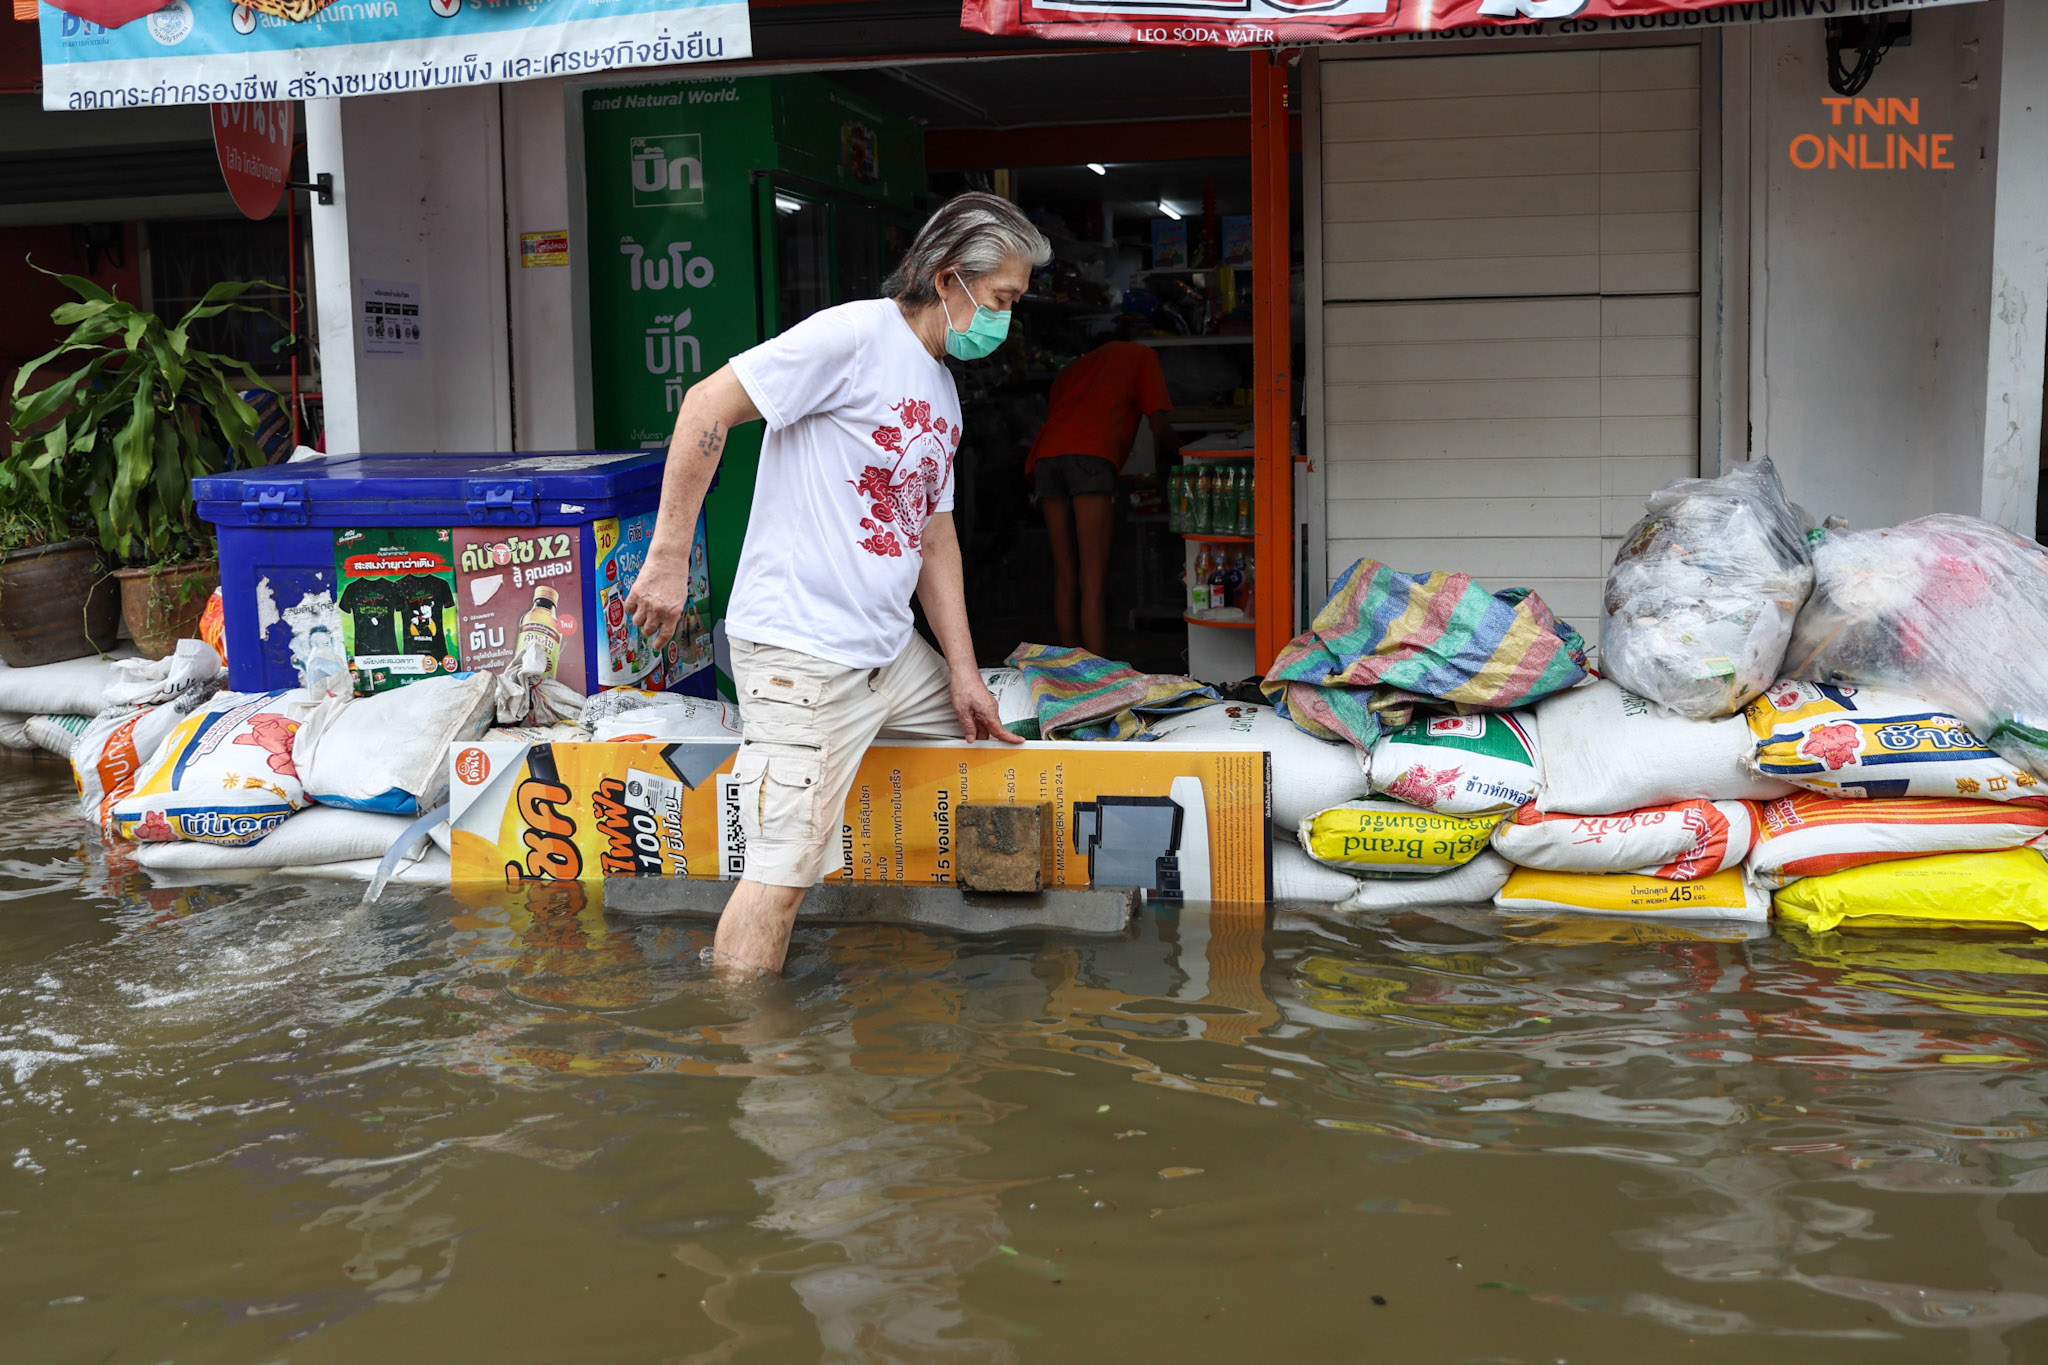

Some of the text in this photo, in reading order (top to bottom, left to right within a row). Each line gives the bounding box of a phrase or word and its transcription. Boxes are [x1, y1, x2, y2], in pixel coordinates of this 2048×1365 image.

[1137, 27, 1167, 42] LEO
[1174, 26, 1220, 42] SODA
[1225, 28, 1275, 43] WATER
[68, 74, 278, 110] ลดภาระค่าครองชีพ
[502, 28, 724, 79] และเศรษฐกิจยั่งยืน
[592, 88, 740, 111] and Natural World.
[620, 241, 715, 291] ไบโอ
[537, 534, 571, 561] X2
[354, 558, 435, 571] สะสมง่ายกว่าเดิม
[560, 620, 573, 629] ใหม่
[469, 622, 505, 651] ตับ
[958, 762, 968, 774] 65
[1003, 768, 1016, 780] นิ้ว
[1055, 773, 1064, 785] 24
[1007, 782, 1016, 794] 50
[1040, 788, 1047, 797] 11
[889, 768, 903, 881] อมแนบภาพถ่ายใบเสร็จ
[933, 789, 950, 855] ของเดือน
[1344, 834, 1490, 861] agle Brand
[877, 856, 888, 881] ดนใจ
[938, 859, 950, 869] 5
[1669, 886, 1692, 902] 45
